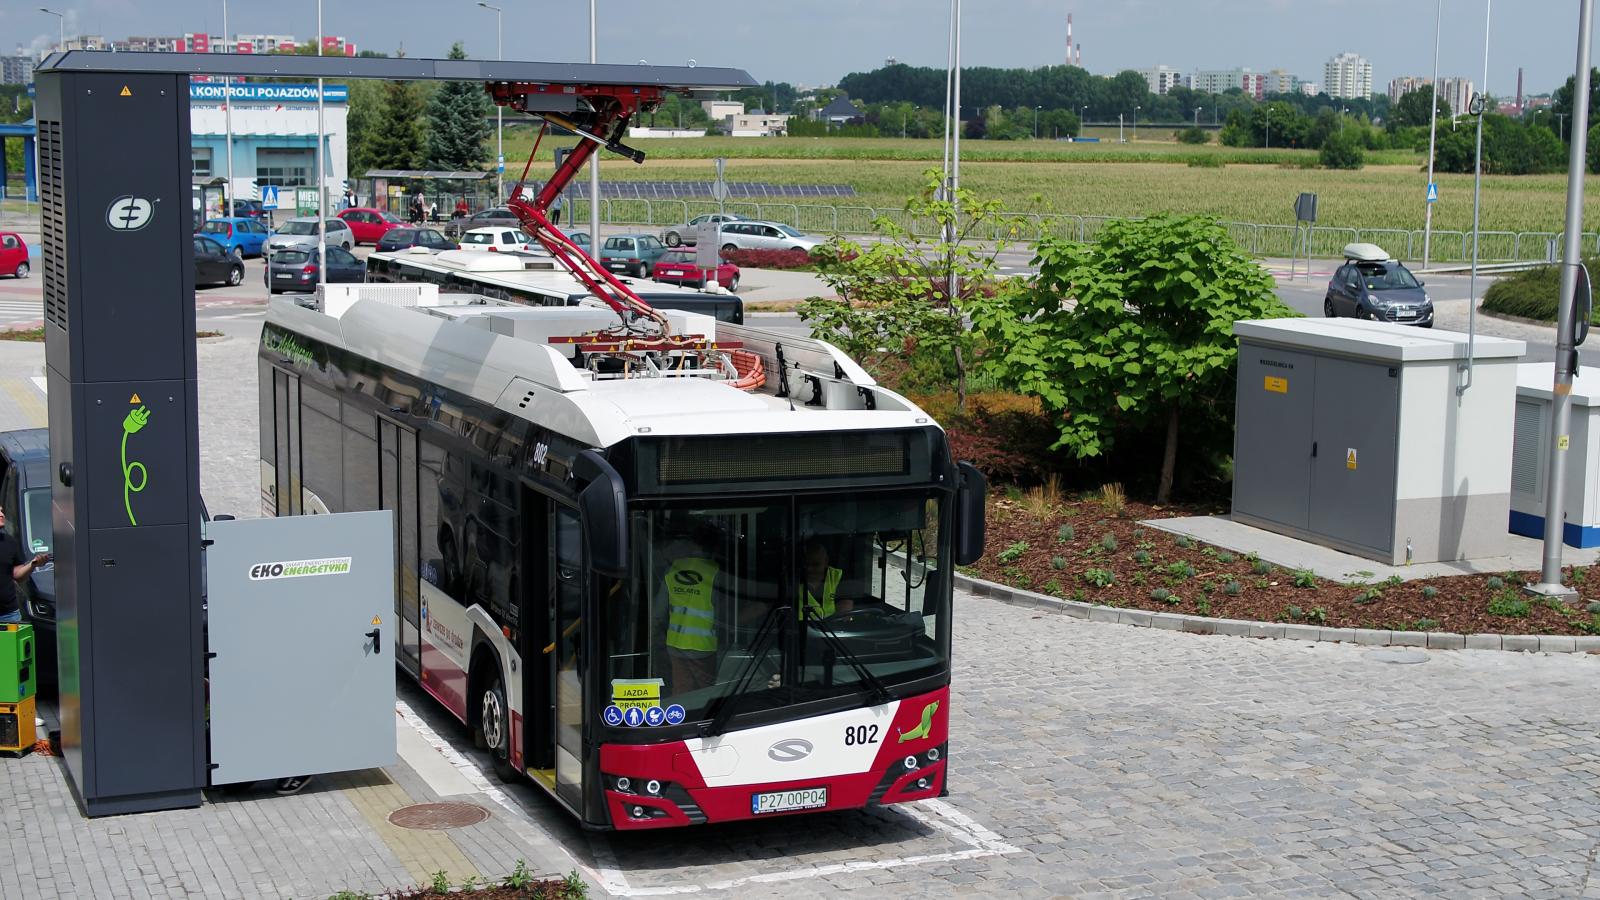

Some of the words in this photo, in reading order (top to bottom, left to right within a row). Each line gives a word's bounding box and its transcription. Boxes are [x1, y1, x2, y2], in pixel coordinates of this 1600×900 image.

[196, 86, 255, 97] KONTROLI
[257, 86, 319, 98] POJAZDÓW
[533, 441, 548, 465] 802
[623, 689, 649, 697] JAZDA
[844, 724, 879, 746] 802
[760, 793, 783, 809] P27
